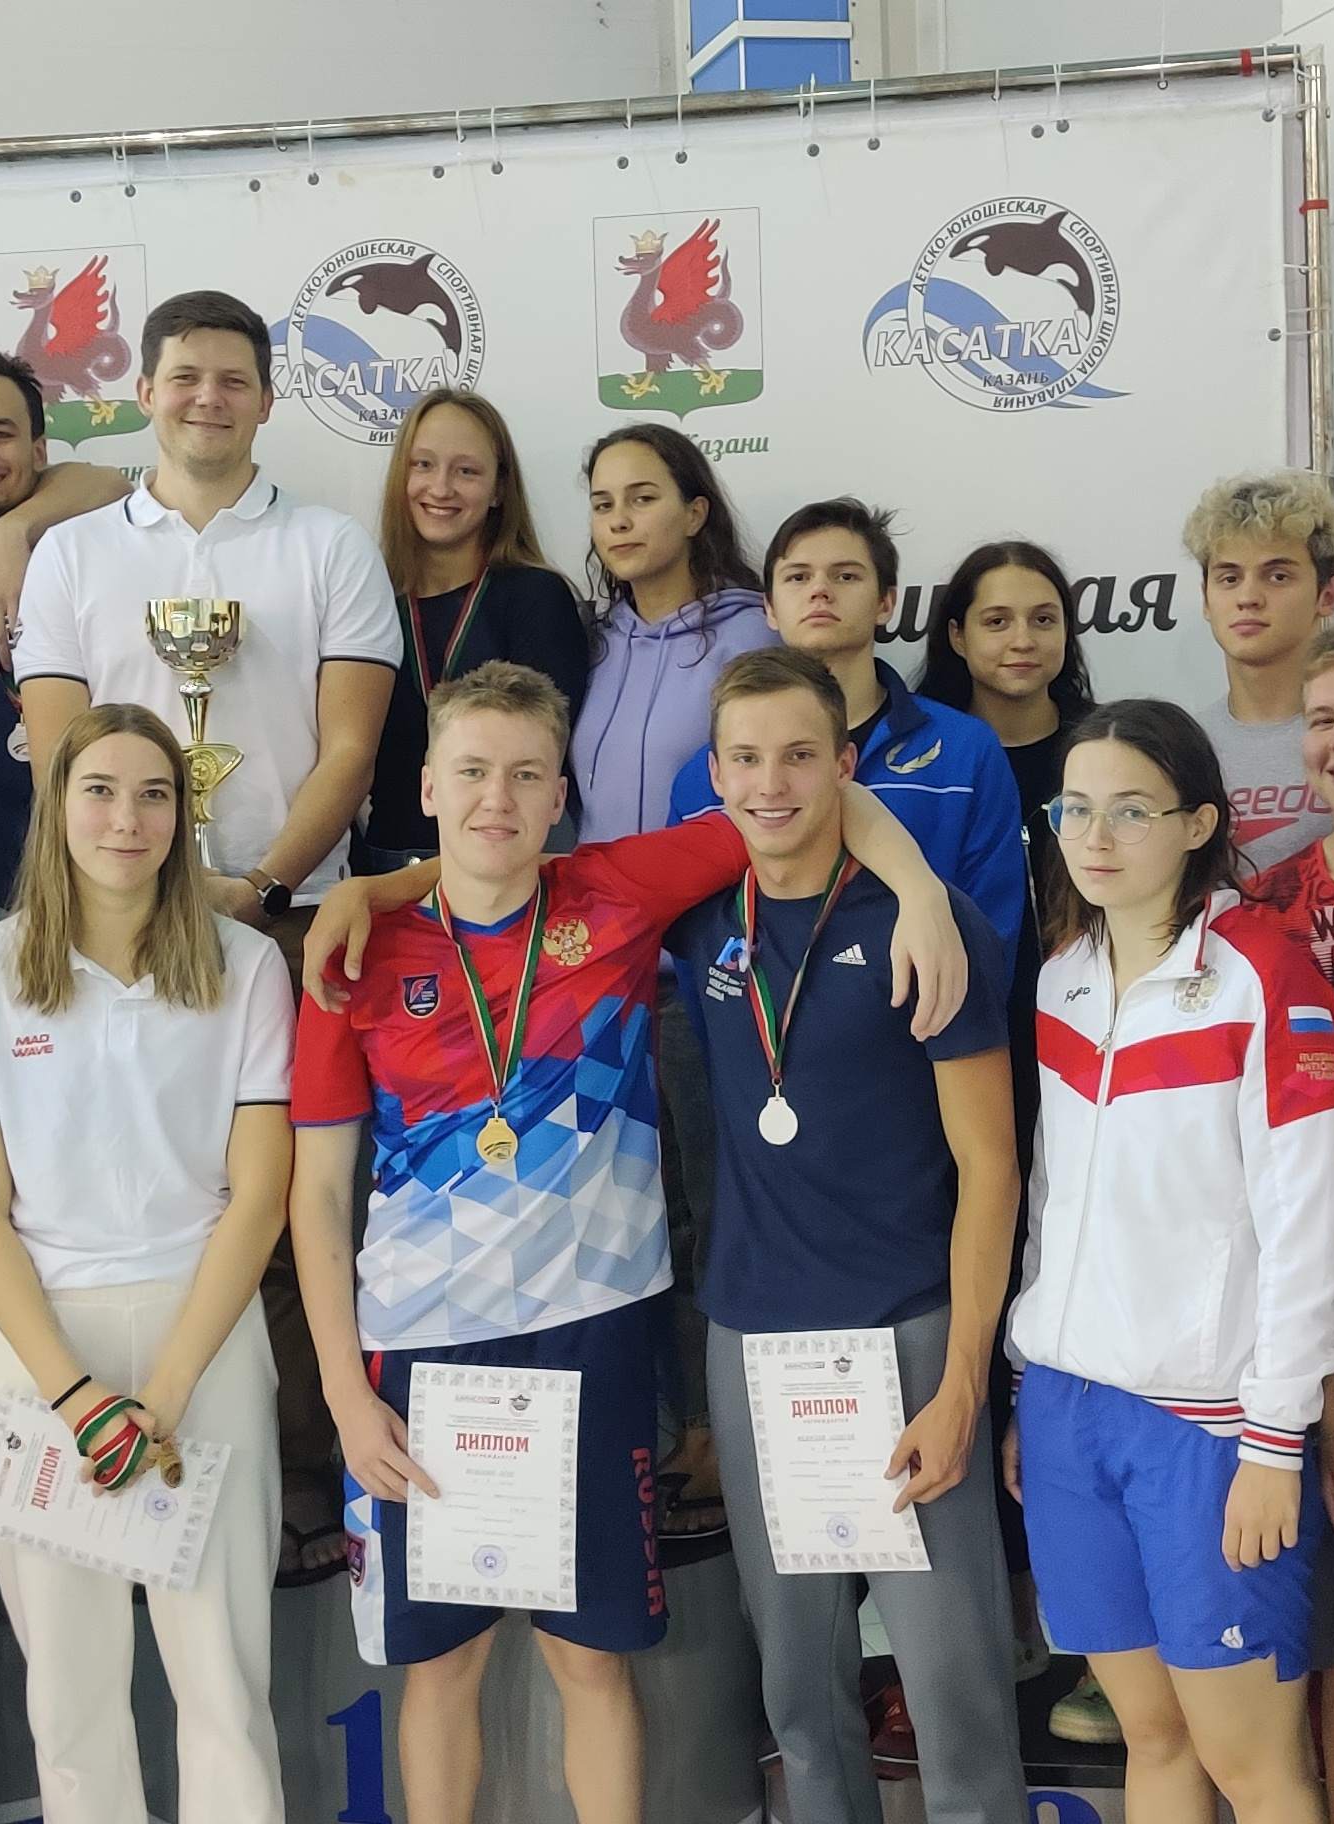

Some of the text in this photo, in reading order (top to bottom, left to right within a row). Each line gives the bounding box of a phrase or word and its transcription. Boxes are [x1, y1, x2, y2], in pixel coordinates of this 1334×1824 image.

[291, 241, 417, 333] ДЕТСКО-ЮНОШЕСКАЯ
[435, 261, 482, 355] СПОРТИВНАЯ
[912, 199, 1117, 409] ДЕТСКО-ЮНОШЕСКАЯ СПОРТИВНАЯ ШКОЛА ПЛАВАНИЯ
[874, 318, 1082, 367] КАСАТКА
[983, 371, 1050, 388] КАЗАНЬ
[684, 432, 770, 462] азани
[11, 1044, 55, 1058] WAVE
[15, 1033, 50, 1046] MAD
[791, 1398, 860, 1418] ДИПЛОМ
[455, 1432, 530, 1453] ДИПЛОМ
[31, 1445, 62, 1511] ДИПЛОМ
[326, 1689, 393, 1824] 1
